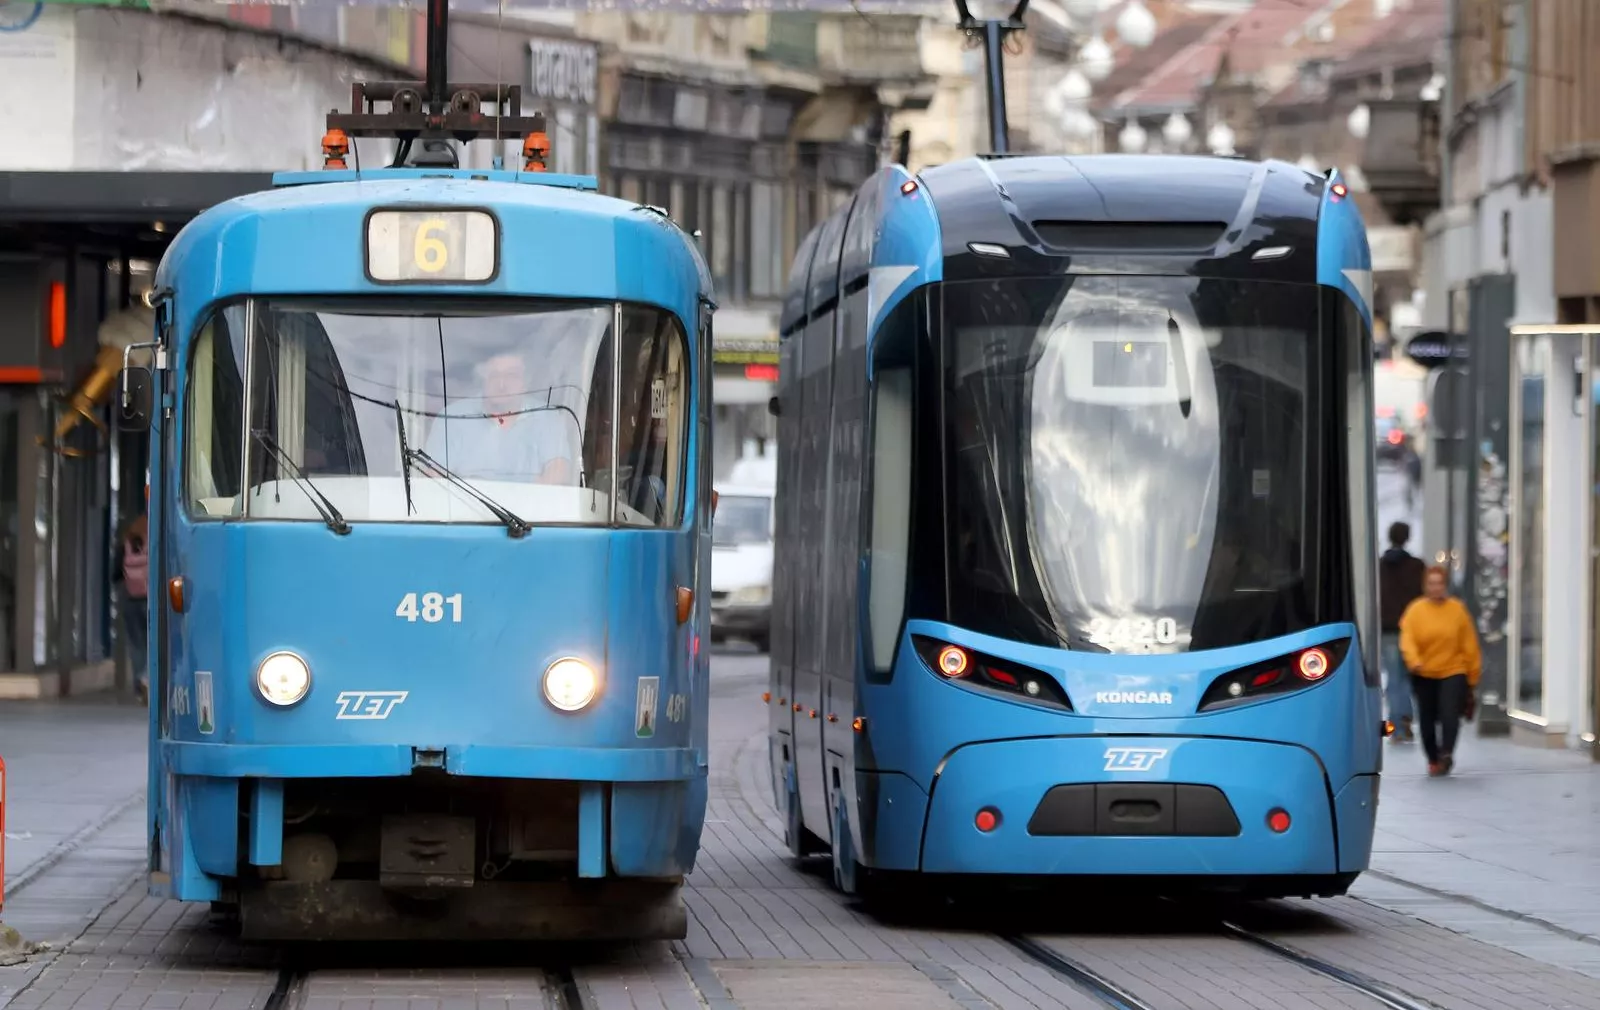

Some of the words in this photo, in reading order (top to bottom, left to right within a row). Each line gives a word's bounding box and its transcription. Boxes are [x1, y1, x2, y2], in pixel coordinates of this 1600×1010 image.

[414, 218, 448, 272] 6
[395, 592, 463, 623] 481
[1089, 617, 1177, 644] 2420
[170, 686, 191, 716] 481
[335, 690, 409, 720] ZET
[665, 693, 687, 723] 481
[1103, 747, 1168, 772] ZET
